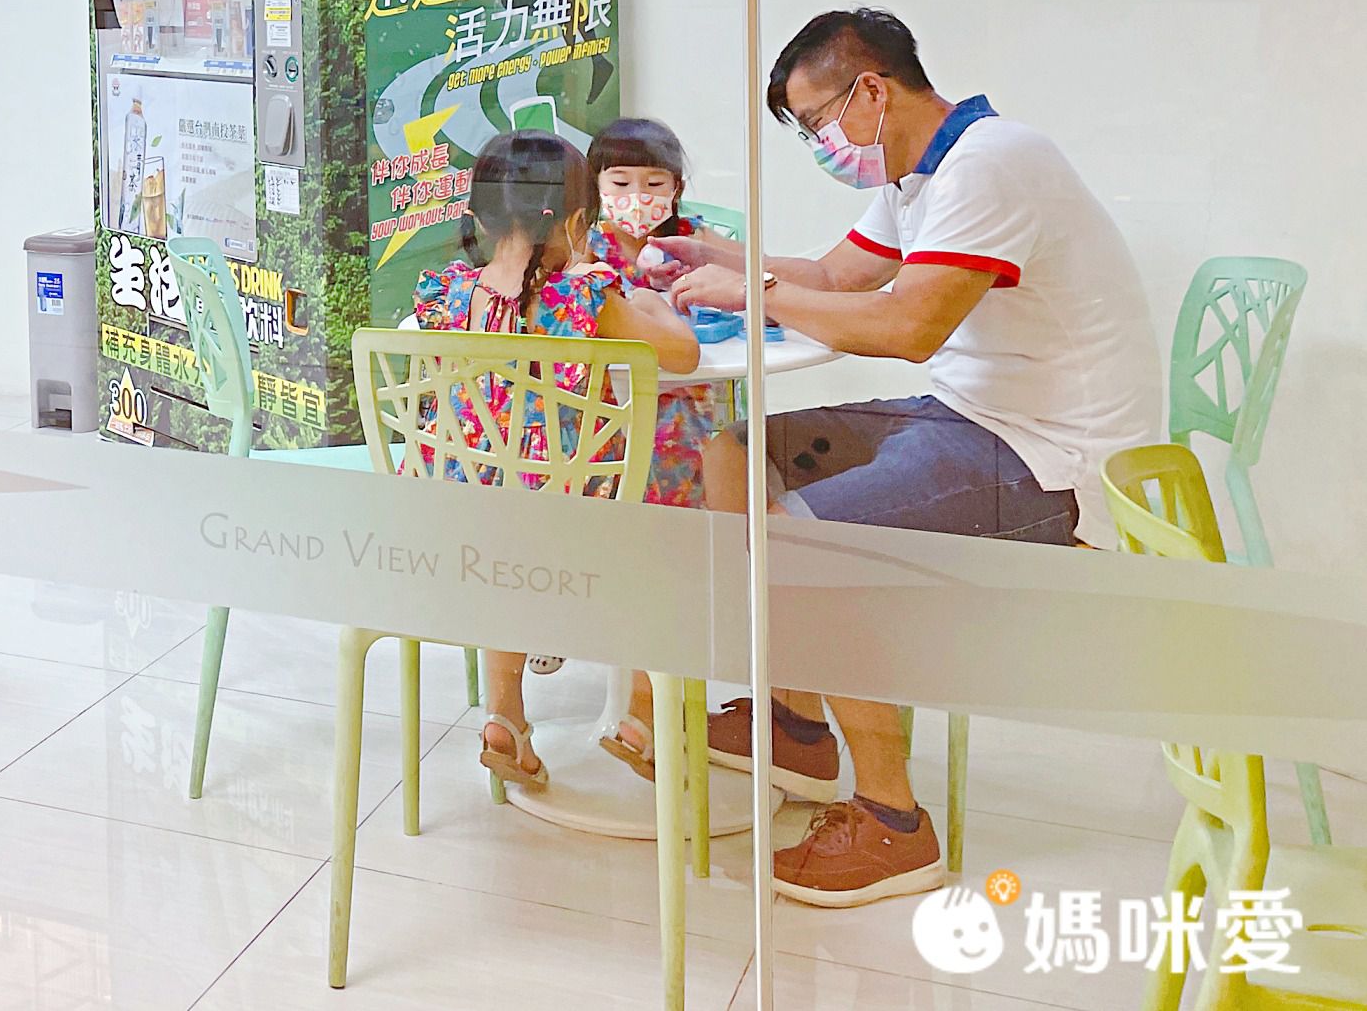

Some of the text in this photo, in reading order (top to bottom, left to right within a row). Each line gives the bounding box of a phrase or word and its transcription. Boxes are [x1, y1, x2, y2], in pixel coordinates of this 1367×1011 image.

[371, 143, 449, 186] 伴你成長
[241, 265, 284, 302] DRINK
[110, 381, 145, 424] 300
